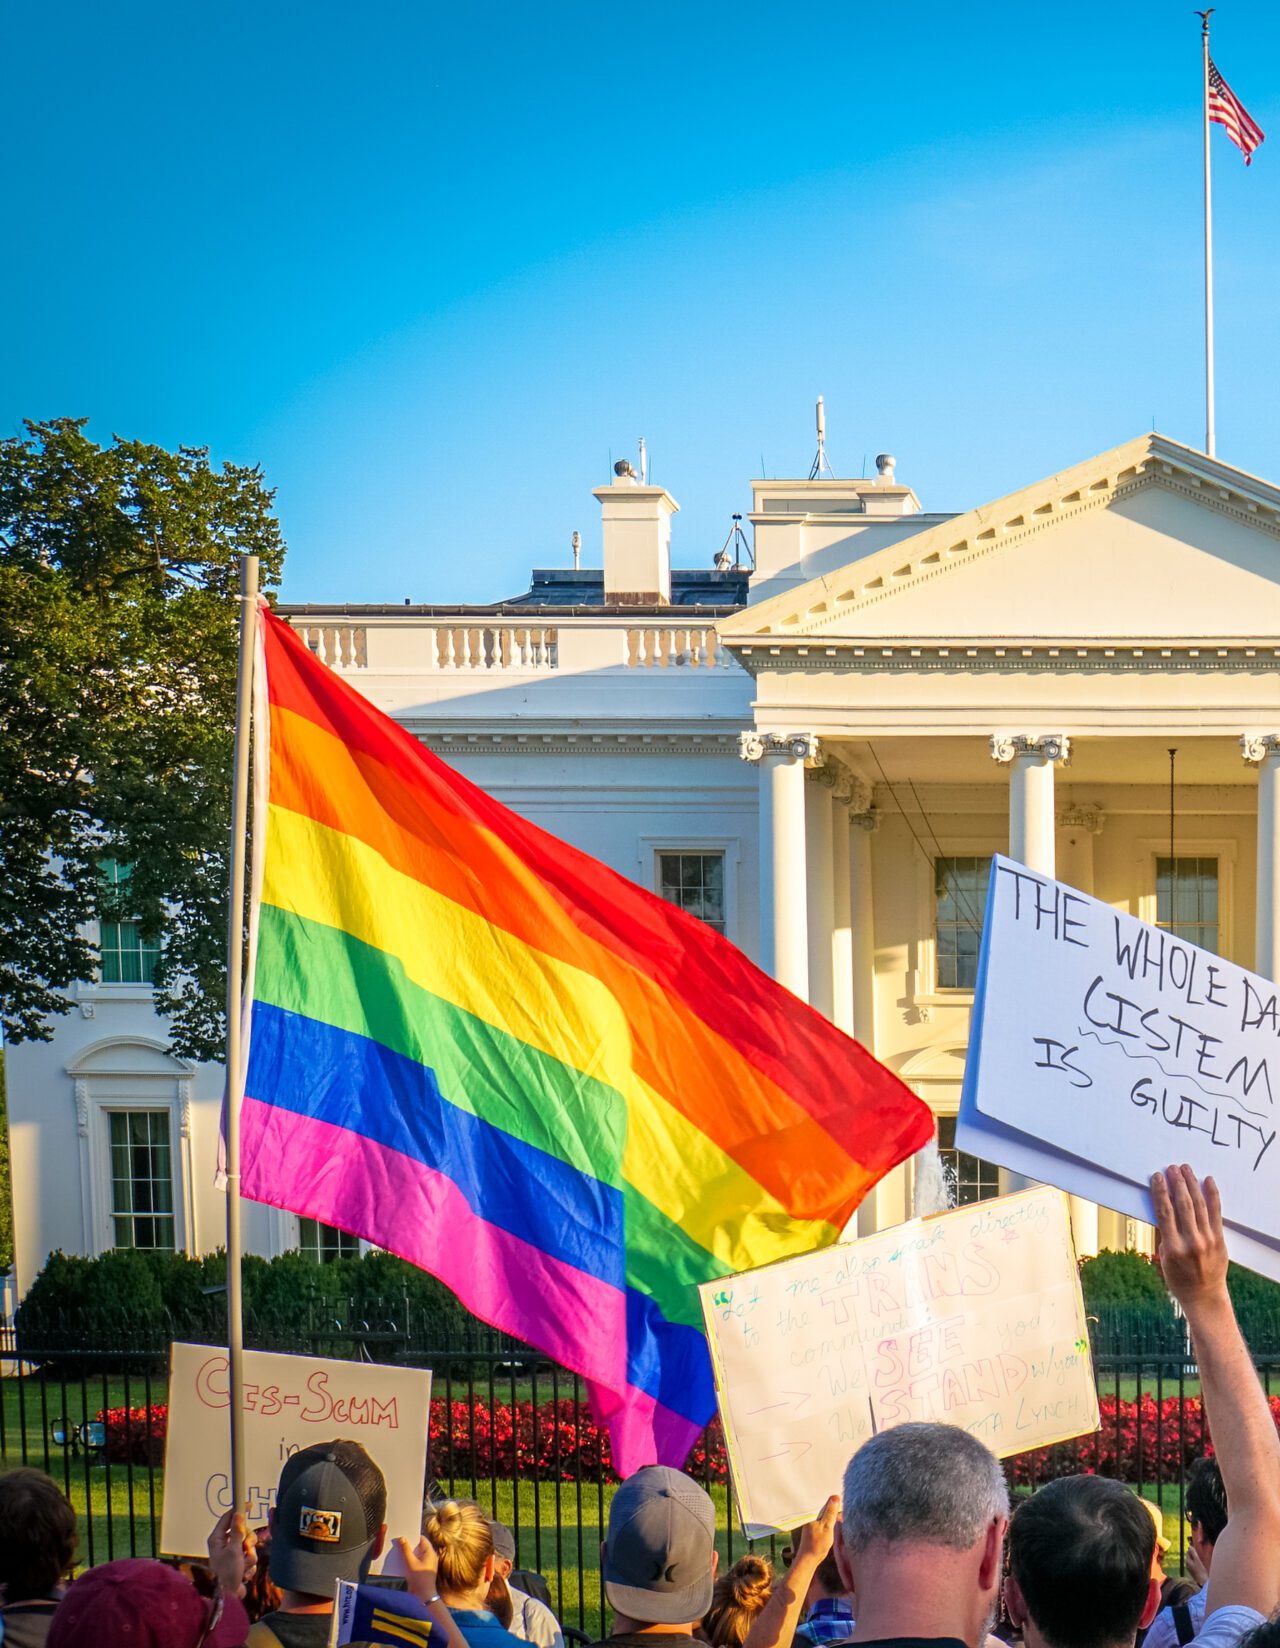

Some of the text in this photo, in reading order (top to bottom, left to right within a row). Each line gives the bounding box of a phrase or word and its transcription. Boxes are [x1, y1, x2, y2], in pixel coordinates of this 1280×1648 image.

[997, 865, 1091, 948] THE
[1114, 916, 1228, 1008] WHOLE
[1084, 976, 1274, 1104] CISTEM
[1032, 1036, 1277, 1172] IS GUILTY
[743, 1242, 1001, 1349] to the TRANS
[785, 1276, 821, 1298] me
[834, 1253, 882, 1285] also
[968, 1202, 1050, 1238] directly
[816, 1356, 866, 1397] We
[828, 1405, 867, 1443] We
[878, 1354, 1029, 1428] STAND
[1015, 1395, 1078, 1430] LYNCH
